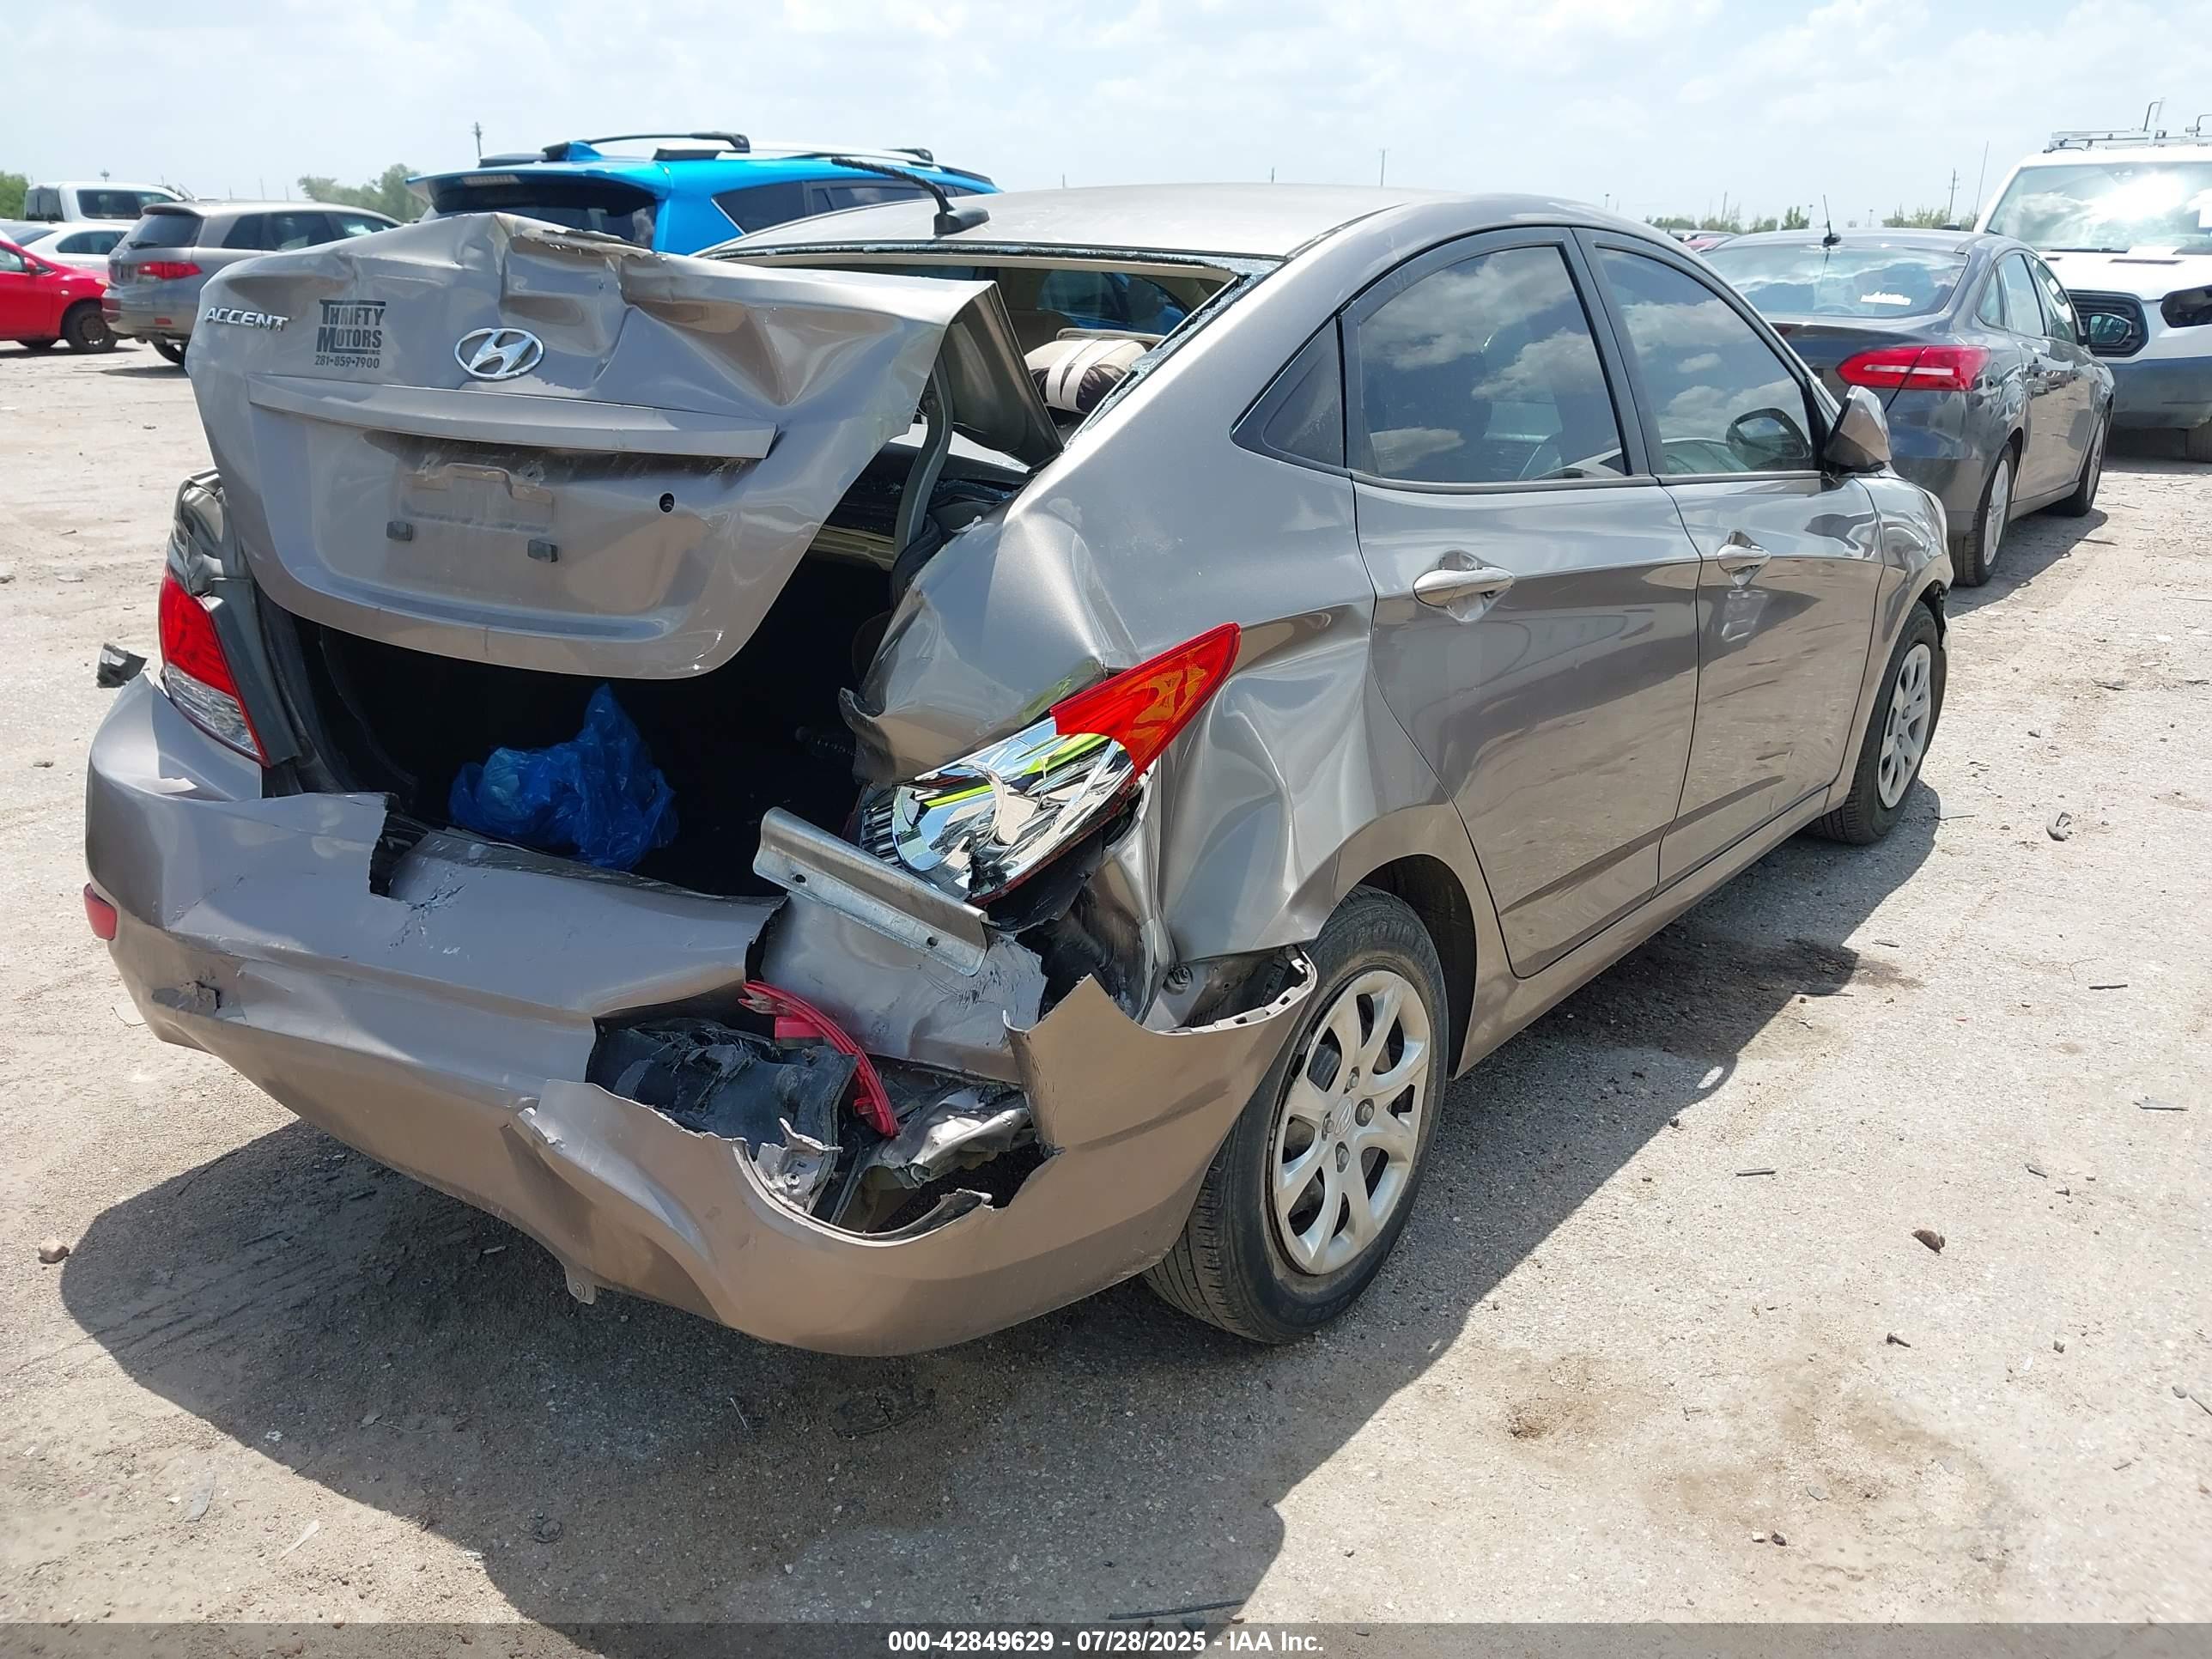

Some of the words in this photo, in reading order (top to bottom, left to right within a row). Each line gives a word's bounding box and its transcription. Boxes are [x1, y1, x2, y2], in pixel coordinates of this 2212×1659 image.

[204, 307, 289, 331] ACCENT
[319, 299, 386, 326] THRIFTY
[316, 327, 382, 354] MOTORS
